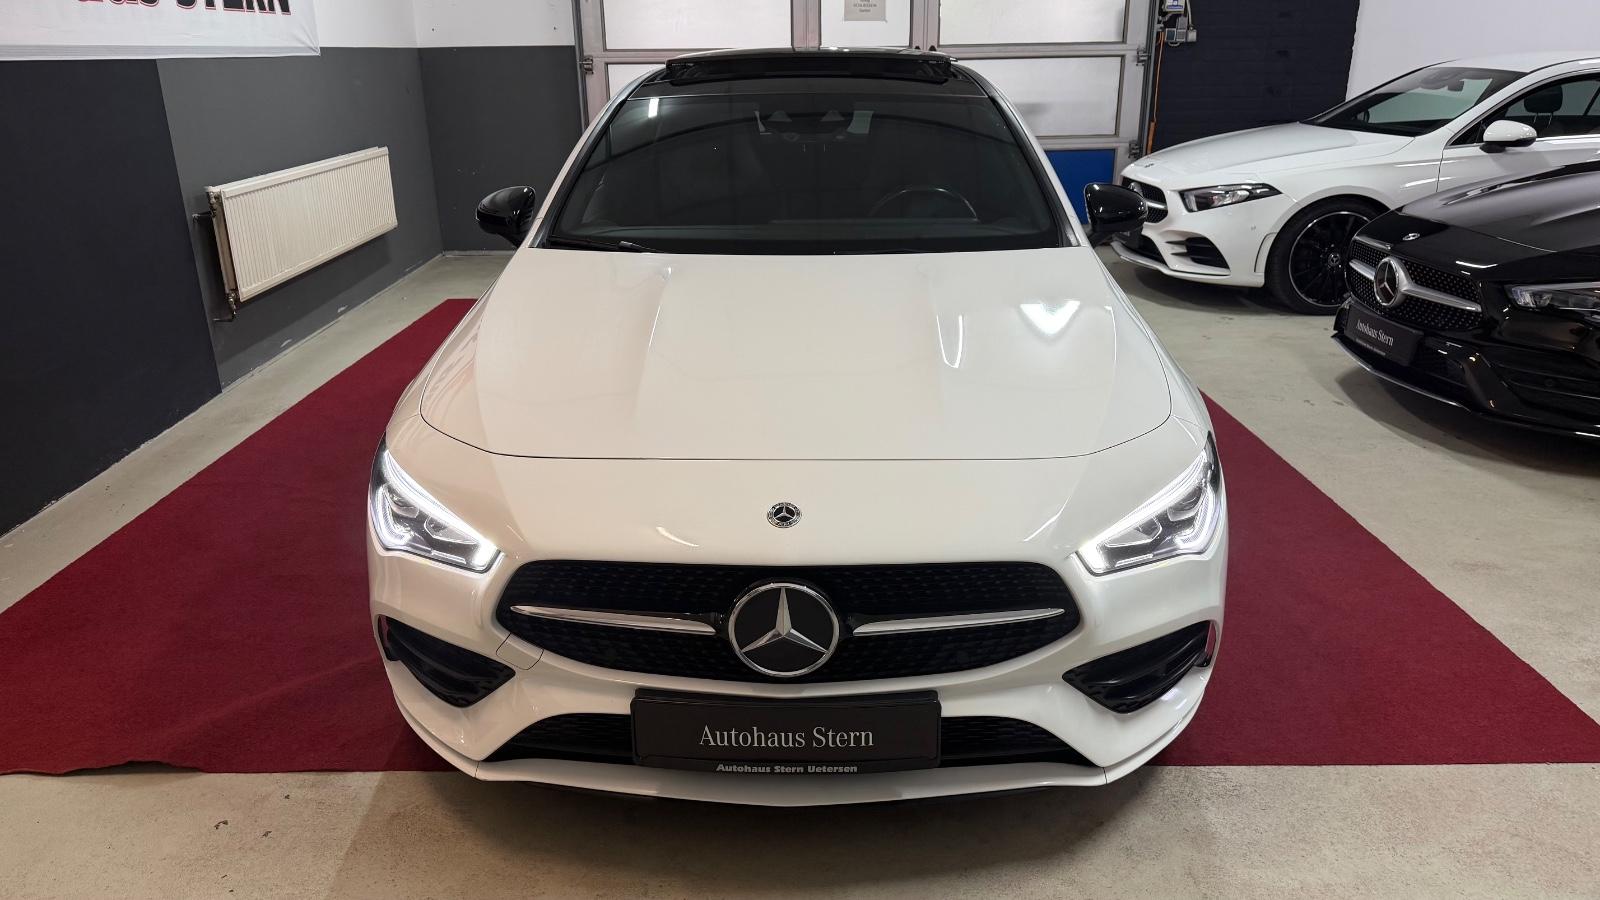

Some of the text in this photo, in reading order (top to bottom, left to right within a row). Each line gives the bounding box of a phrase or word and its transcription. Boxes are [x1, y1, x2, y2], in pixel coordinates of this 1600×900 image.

[1356, 319, 1379, 339] Autohaus
[1377, 329, 1394, 347] Stern
[699, 724, 874, 748] Autohaus Stern
[716, 763, 771, 773] Autohaus
[773, 765, 804, 773] Stern
